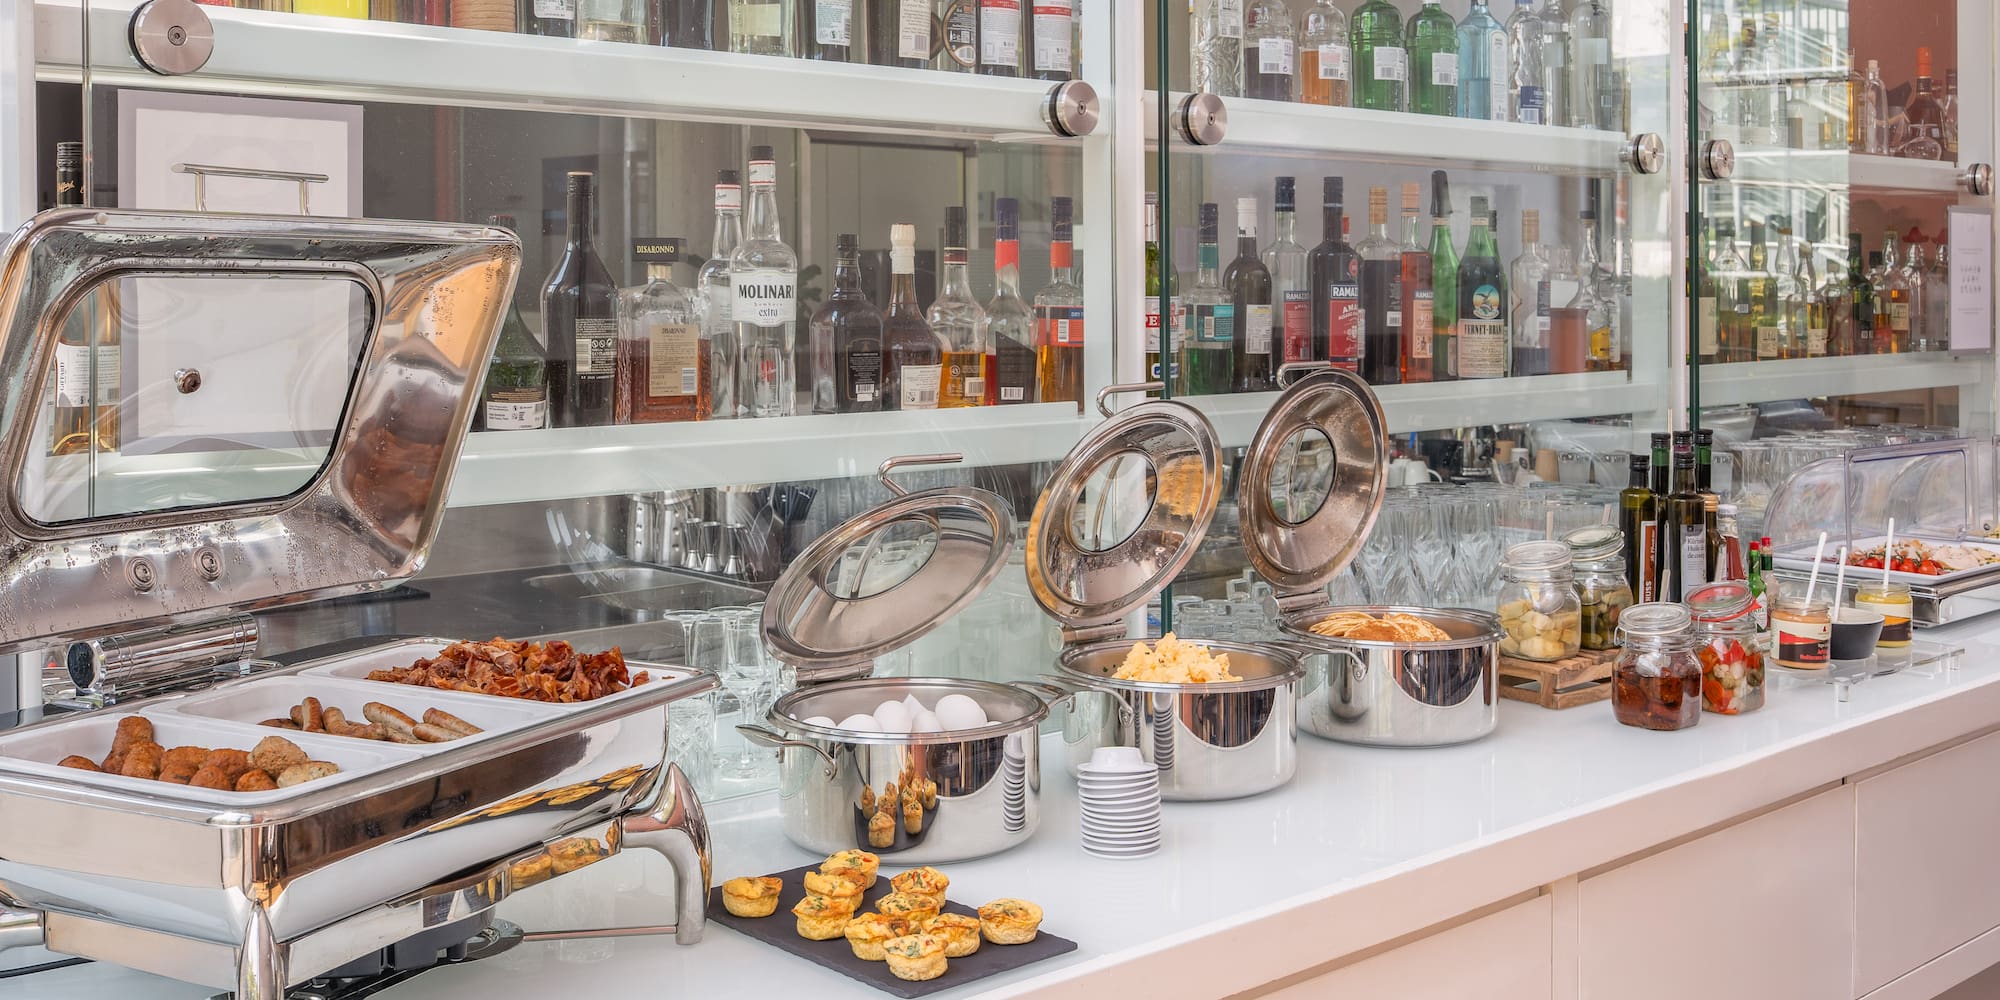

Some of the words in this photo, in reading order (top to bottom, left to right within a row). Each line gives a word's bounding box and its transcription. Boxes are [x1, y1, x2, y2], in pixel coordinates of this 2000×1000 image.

[636, 245, 675, 254] DISARONNO
[738, 284, 794, 299] MOLINARI
[758, 307, 778, 317] extra
